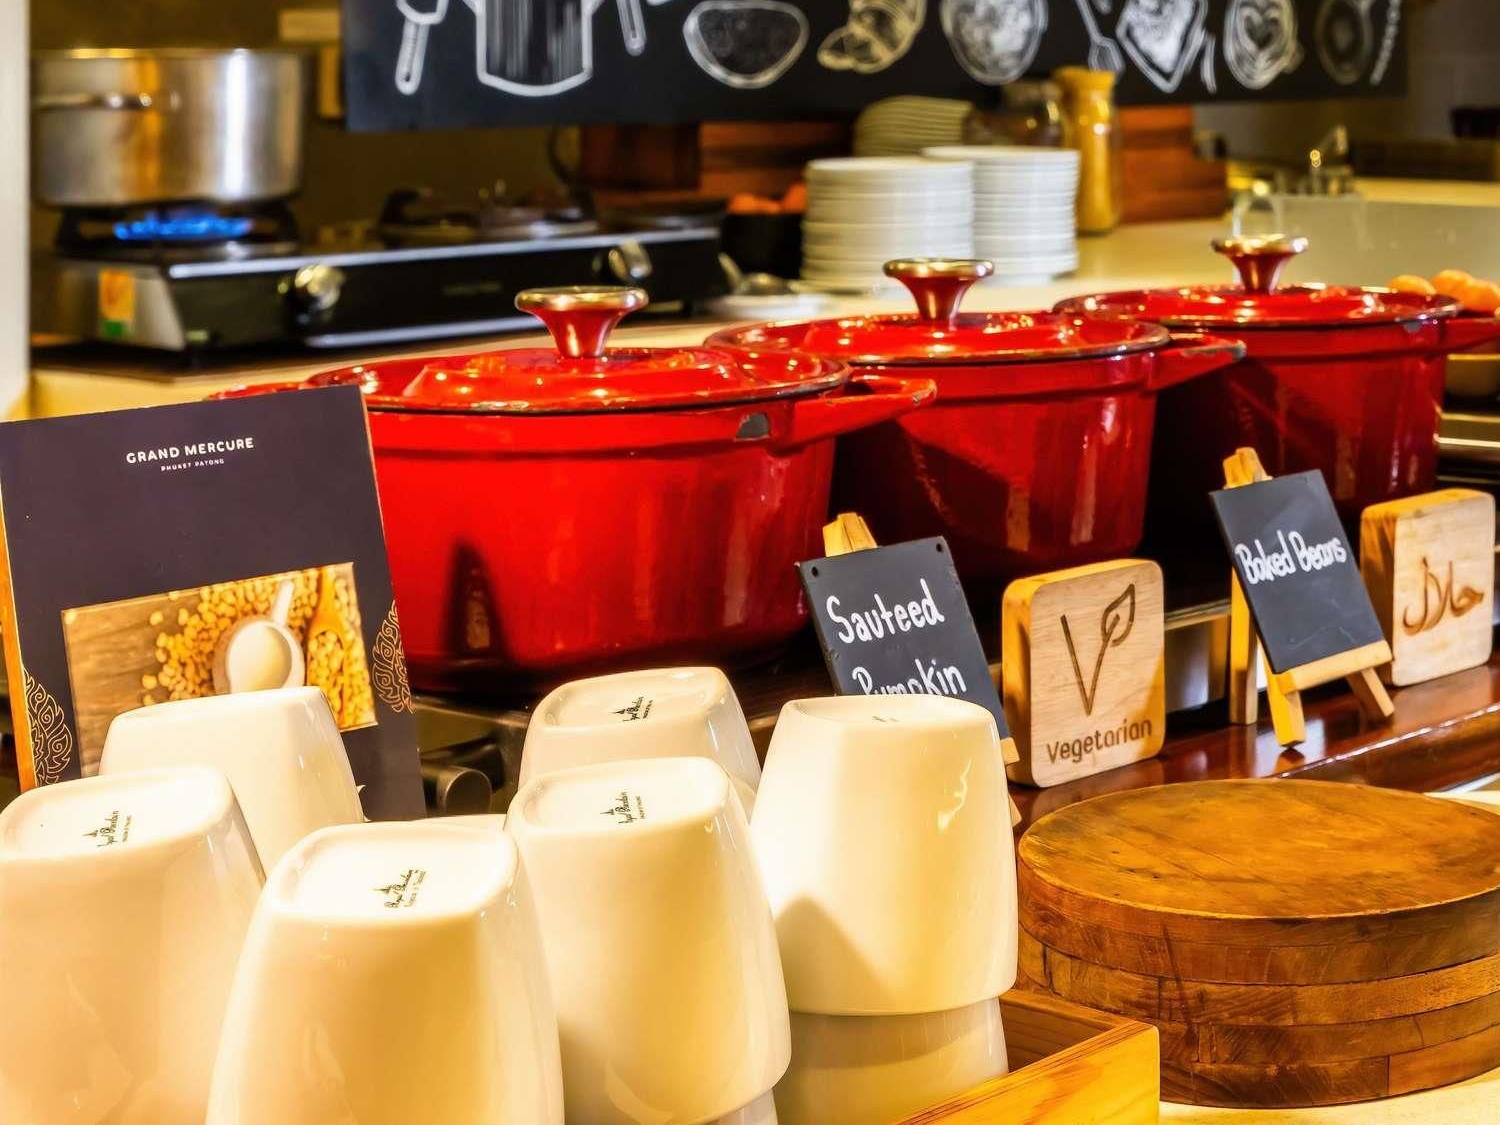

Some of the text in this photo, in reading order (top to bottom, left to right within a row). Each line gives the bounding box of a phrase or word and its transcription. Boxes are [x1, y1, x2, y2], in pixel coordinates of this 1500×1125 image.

[126, 437, 254, 464] GRAND MERCURE
[1234, 529, 1347, 585] Baked Beans
[826, 578, 945, 644] Sauteed
[1402, 556, 1485, 636] حلال
[852, 658, 967, 696] Pmkin
[1046, 718, 1152, 764] Vegetarian
